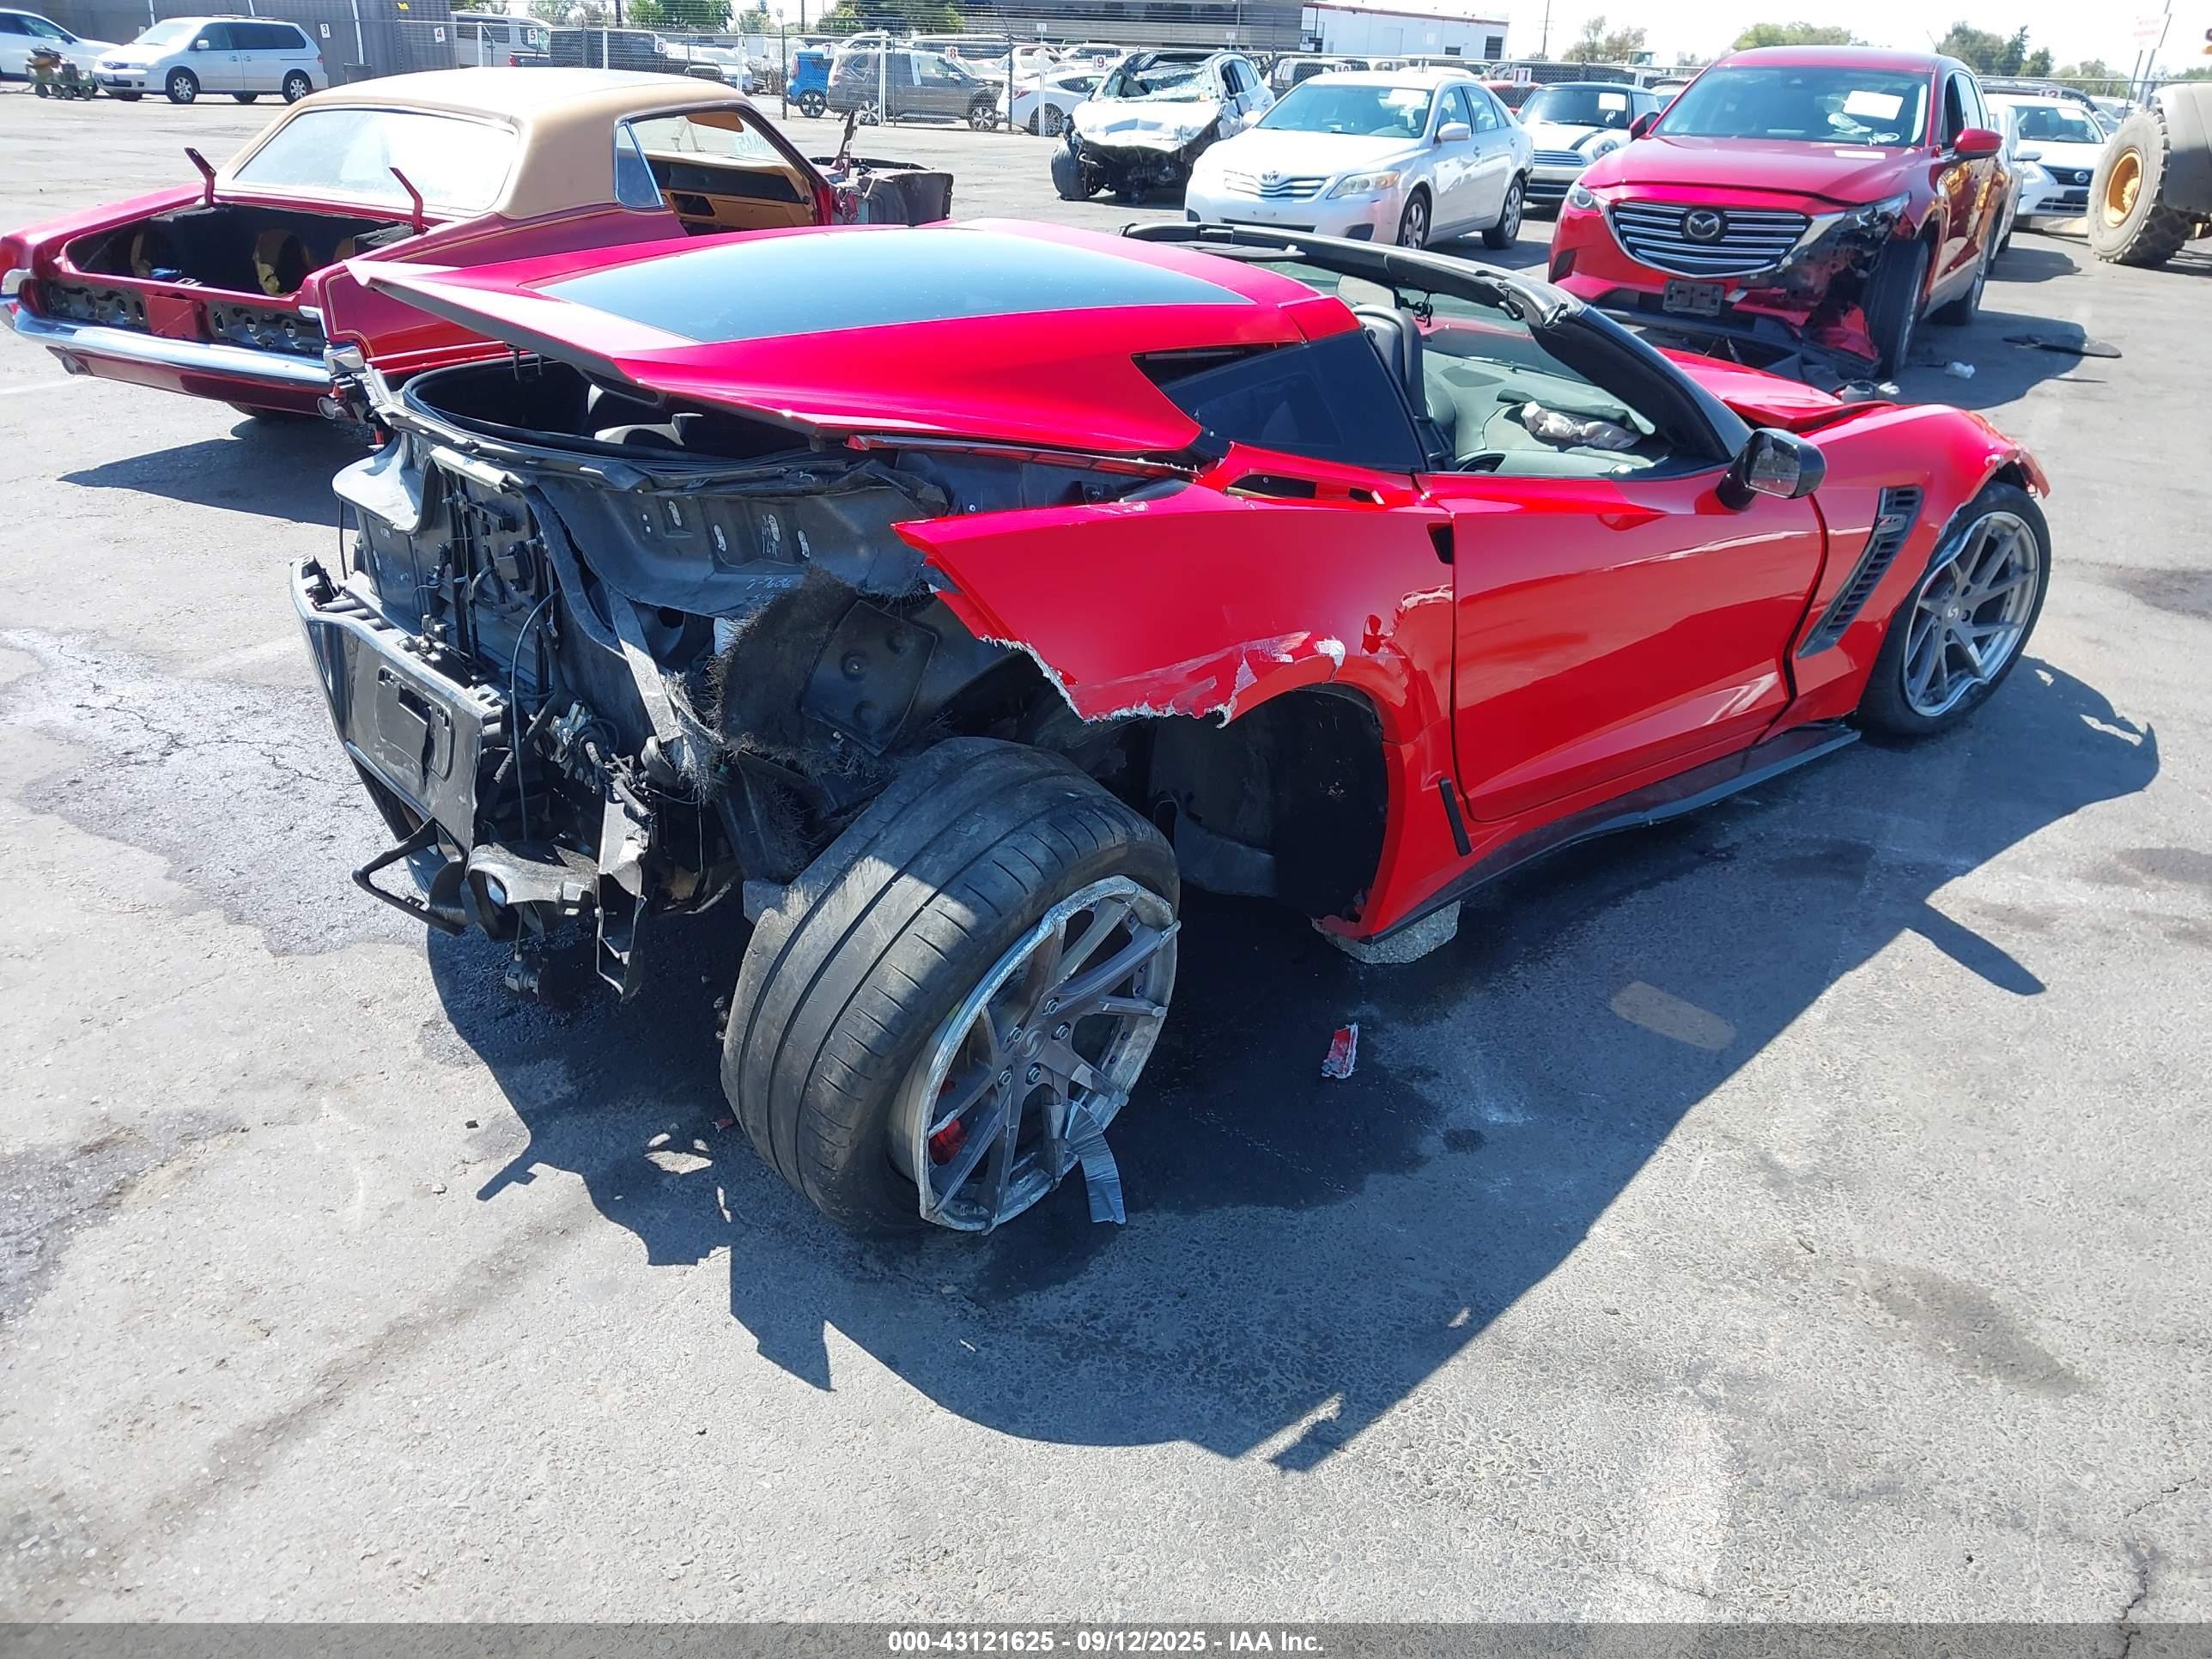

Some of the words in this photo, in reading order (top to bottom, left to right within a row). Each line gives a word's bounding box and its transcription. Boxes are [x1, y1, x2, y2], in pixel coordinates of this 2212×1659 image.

[322, 25, 328, 34] 3
[436, 28, 442, 39] 4
[530, 30, 536, 40] 5
[657, 42, 664, 52] 6
[824, 44, 831, 54] 7
[950, 48, 957, 59] 8
[1097, 56, 1105, 68] 9
[1516, 70, 1528, 82] 11
